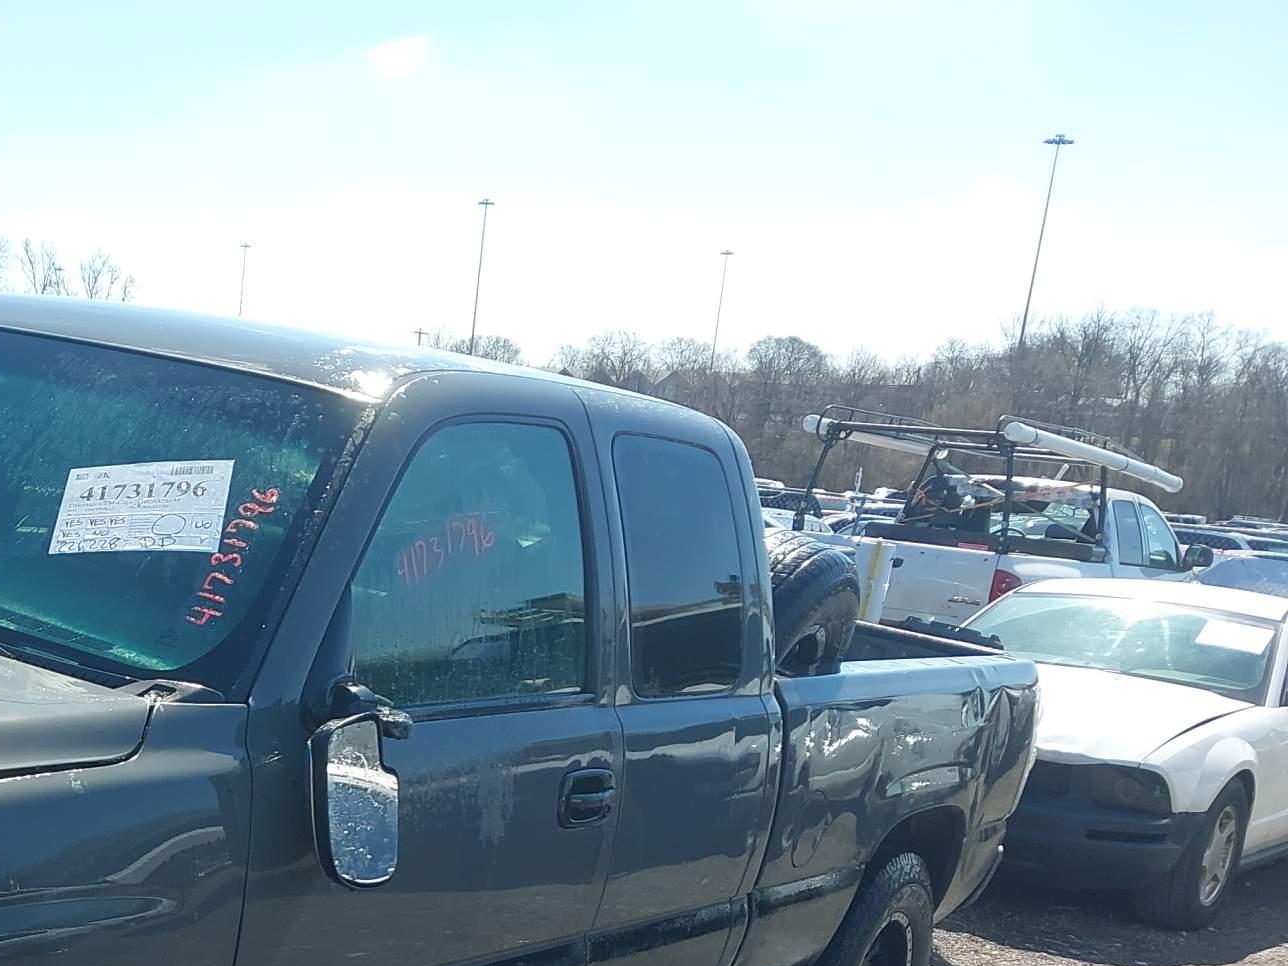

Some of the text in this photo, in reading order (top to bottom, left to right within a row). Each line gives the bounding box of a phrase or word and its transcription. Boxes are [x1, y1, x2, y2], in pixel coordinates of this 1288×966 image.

[79, 480, 210, 502] 41731796
[185, 487, 281, 626] 41731796
[396, 512, 496, 587] 41731796
